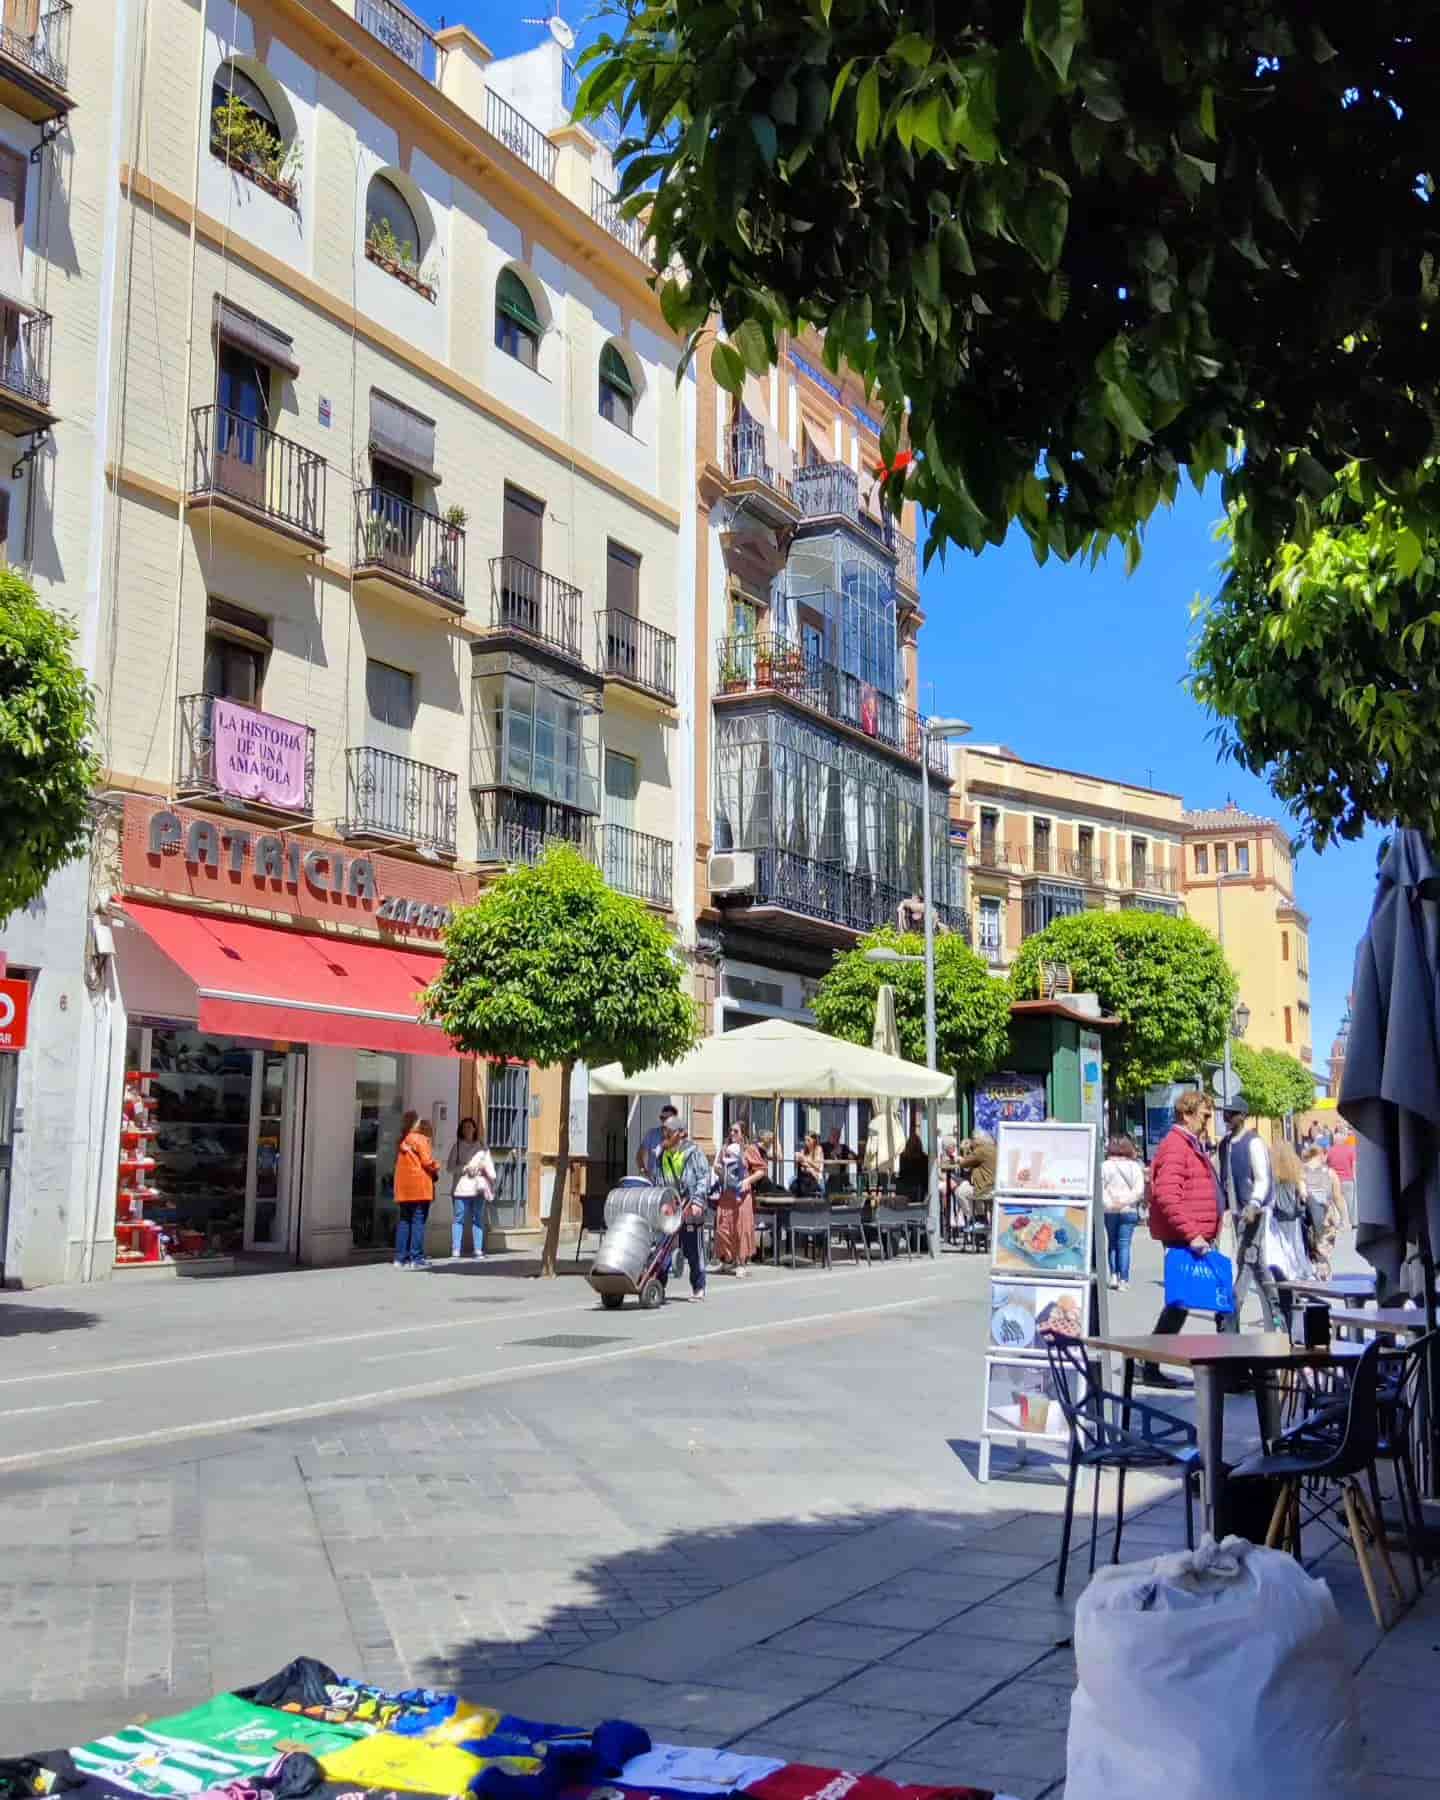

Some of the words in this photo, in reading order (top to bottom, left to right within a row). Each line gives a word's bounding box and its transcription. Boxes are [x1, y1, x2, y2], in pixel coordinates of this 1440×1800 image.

[219, 711, 237, 732] LA
[240, 718, 301, 752] HISTORIA
[236, 737, 256, 756] DE
[259, 743, 284, 766] UNA
[228, 754, 291, 787] AMAPOLA
[149, 810, 375, 900] PATRICIA
